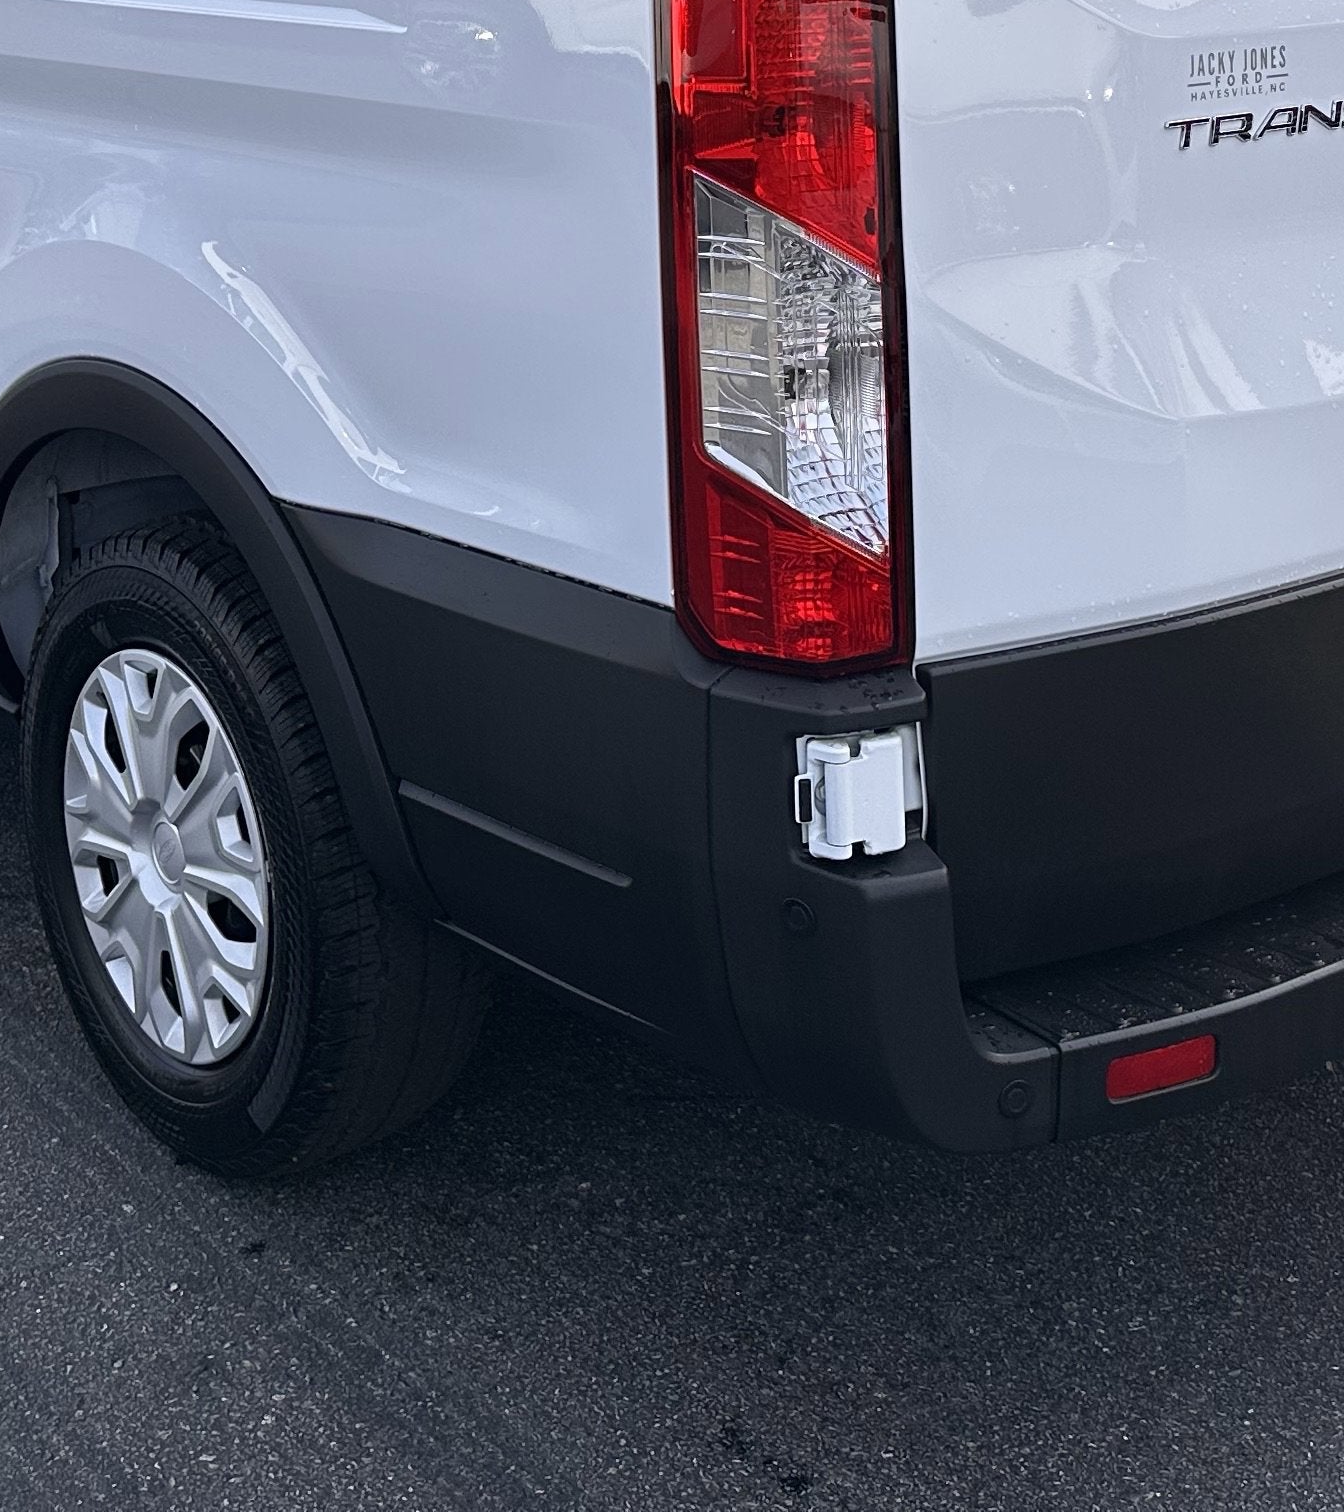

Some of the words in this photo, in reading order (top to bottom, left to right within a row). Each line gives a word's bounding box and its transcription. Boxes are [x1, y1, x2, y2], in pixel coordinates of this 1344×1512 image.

[1190, 50, 1235, 78] JACKY
[1243, 45, 1286, 72] JONES
[1215, 71, 1263, 88] FORD
